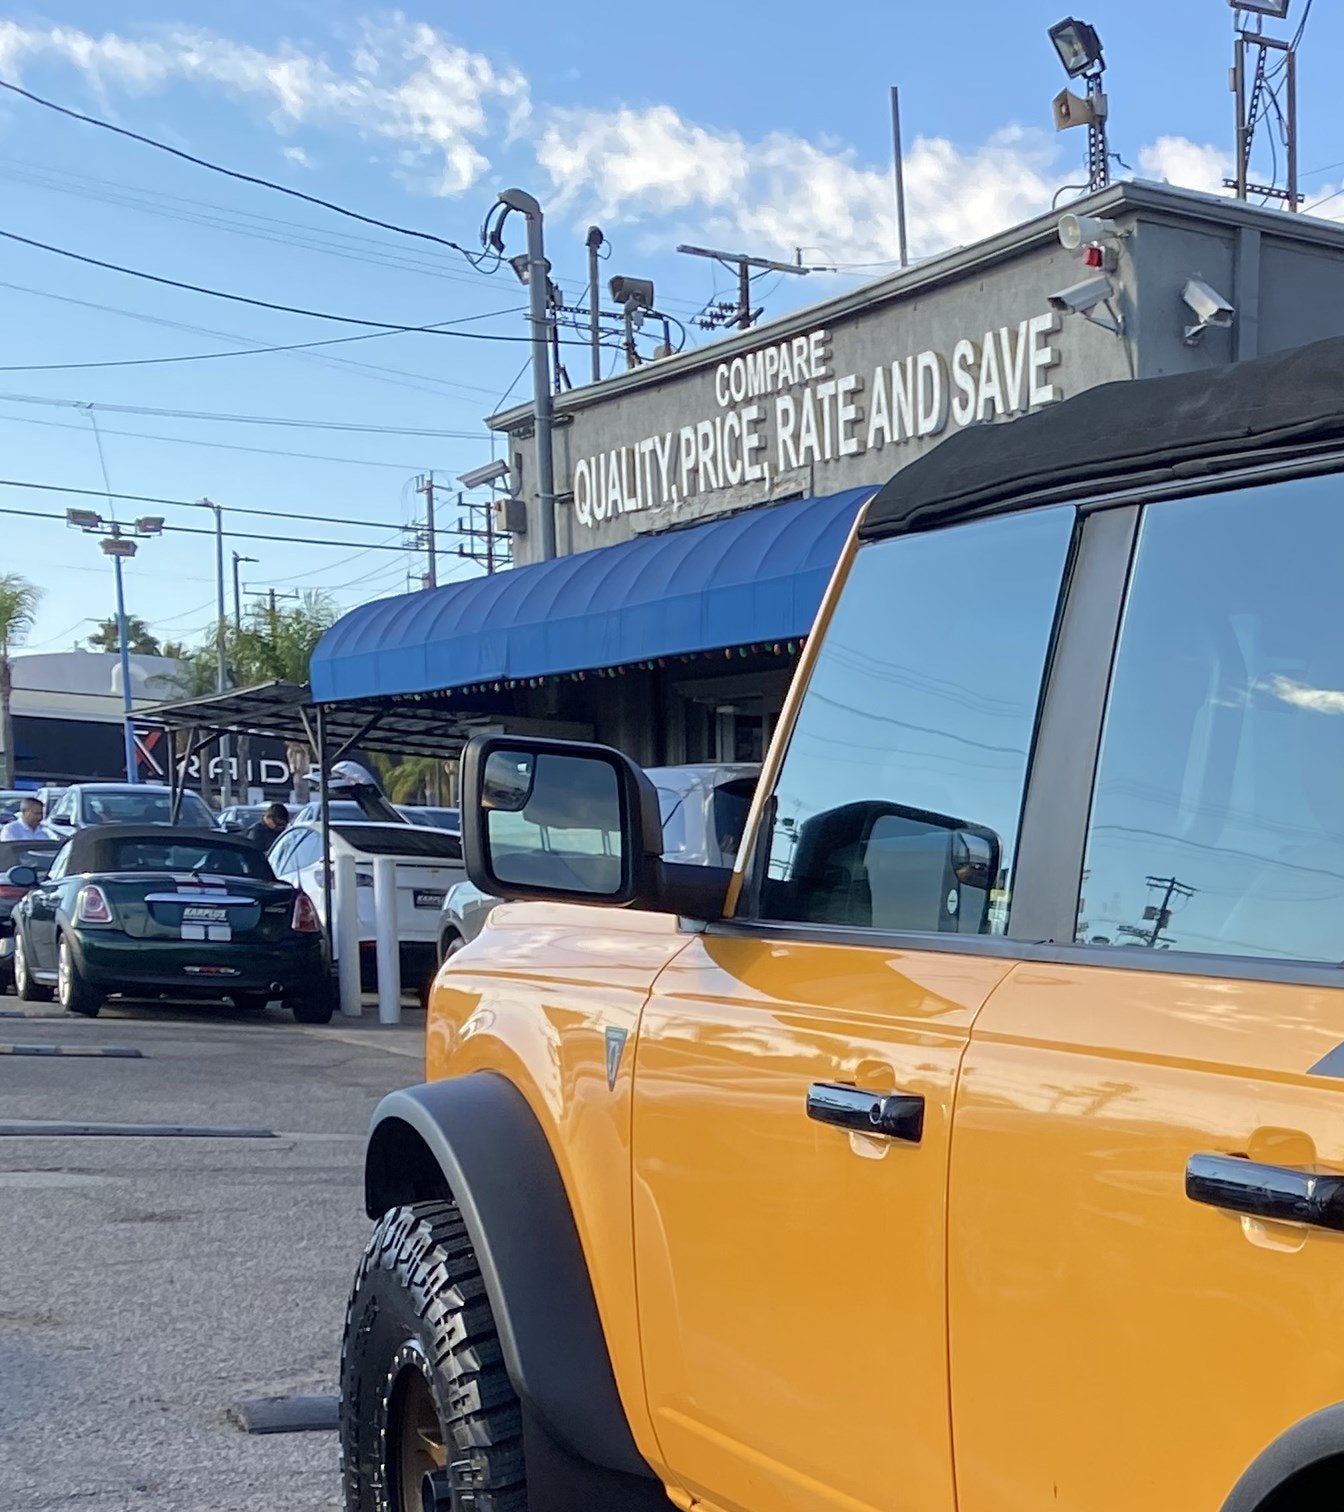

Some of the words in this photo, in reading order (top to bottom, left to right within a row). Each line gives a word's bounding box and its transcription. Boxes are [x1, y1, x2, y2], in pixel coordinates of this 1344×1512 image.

[714, 328, 832, 408] COMPARE
[776, 374, 864, 471] RATE
[866, 350, 948, 450] AND
[951, 312, 1063, 428] SAVE
